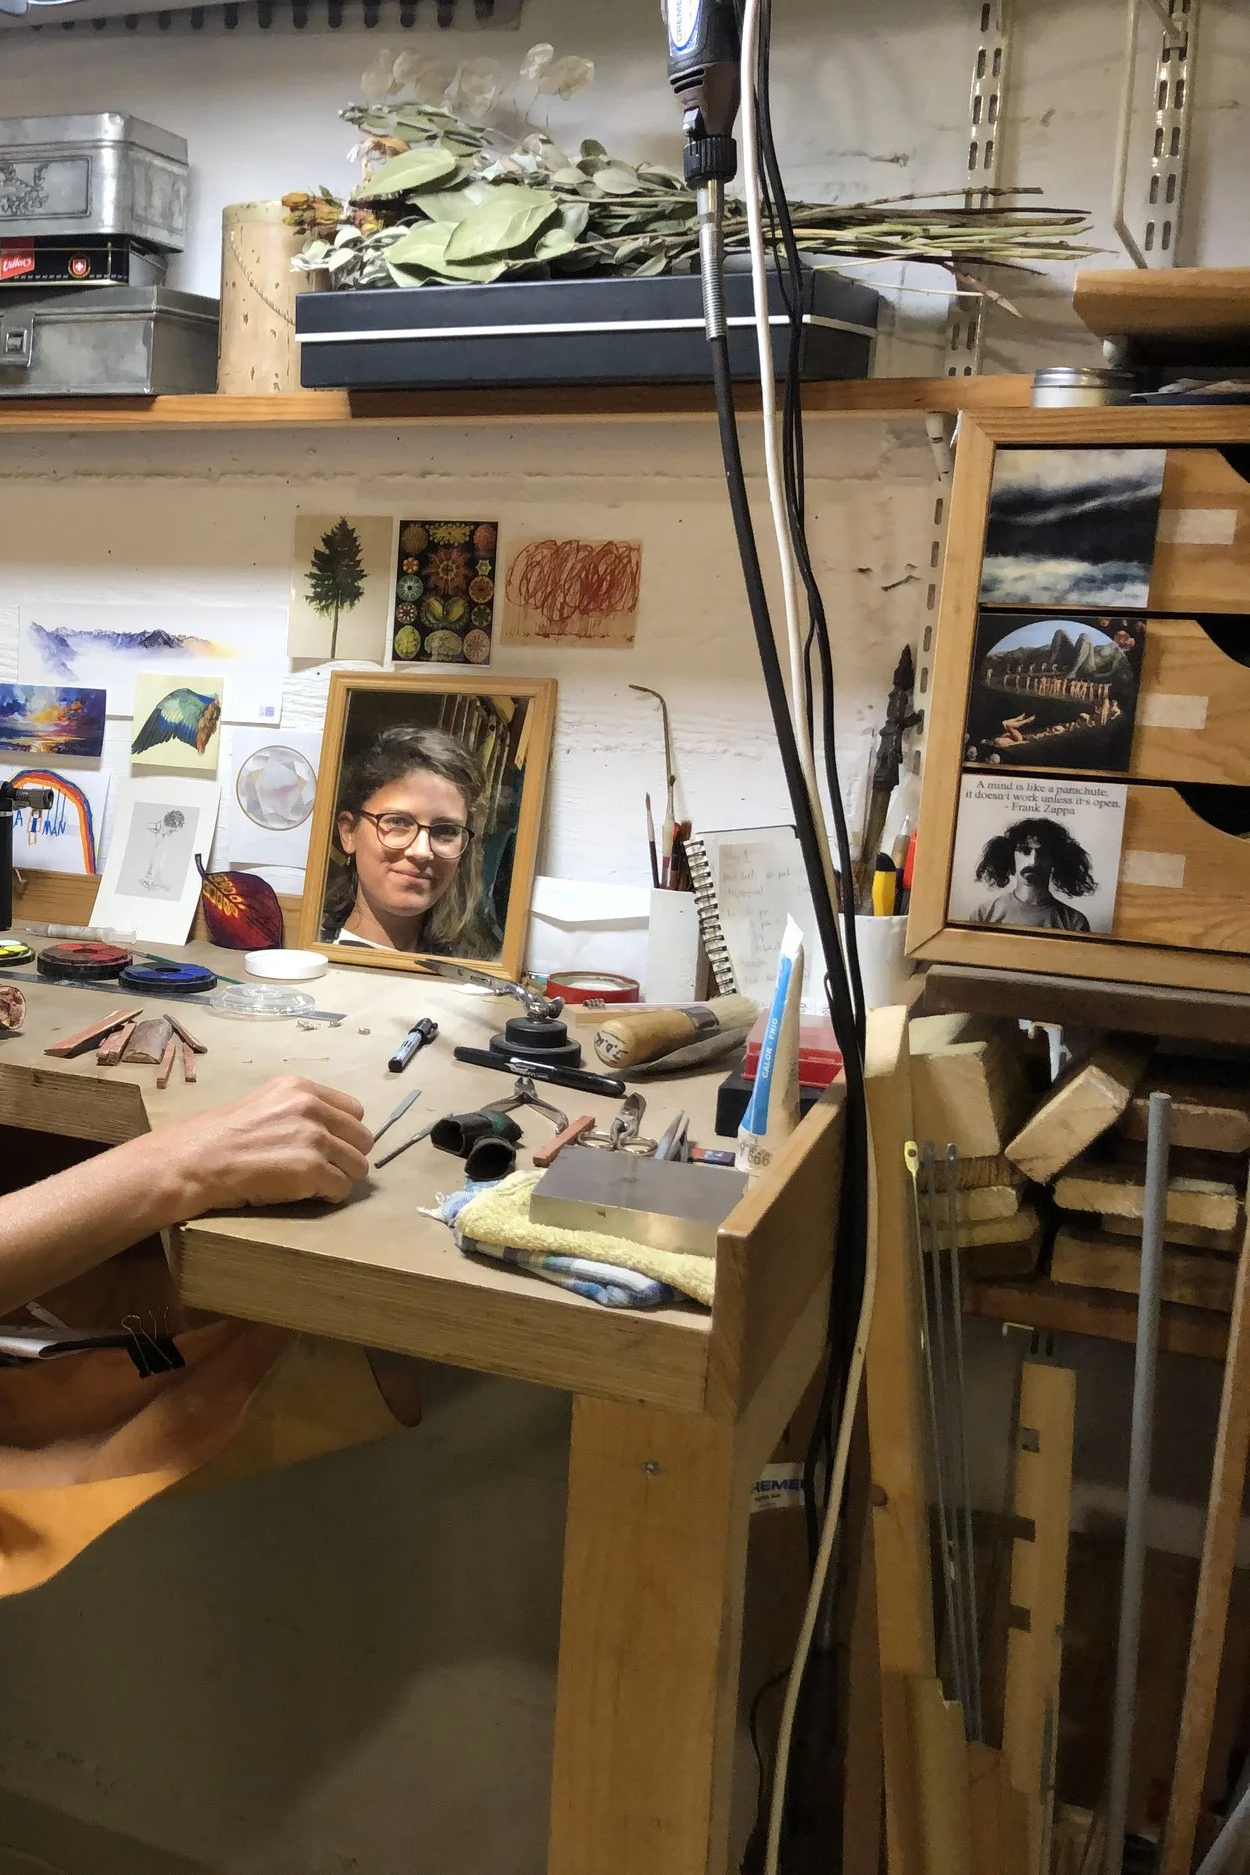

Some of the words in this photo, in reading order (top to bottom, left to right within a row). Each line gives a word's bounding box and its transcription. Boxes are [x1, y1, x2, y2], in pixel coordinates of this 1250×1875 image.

[965, 790, 973, 799] it
[974, 790, 1010, 801] doesn't
[1013, 793, 1039, 803] work
[1041, 794, 1073, 805] unless
[976, 780, 985, 789] A
[987, 781, 1013, 791] mind
[1015, 783, 1025, 792] is
[1027, 782, 1046, 793] like
[1055, 785, 1109, 798] parachute,
[1011, 801, 1041, 813] Frank
[1042, 803, 1076, 817] Zappa
[761, 1047, 773, 1079] CALOR
[769, 1017, 778, 1040] FRIO
